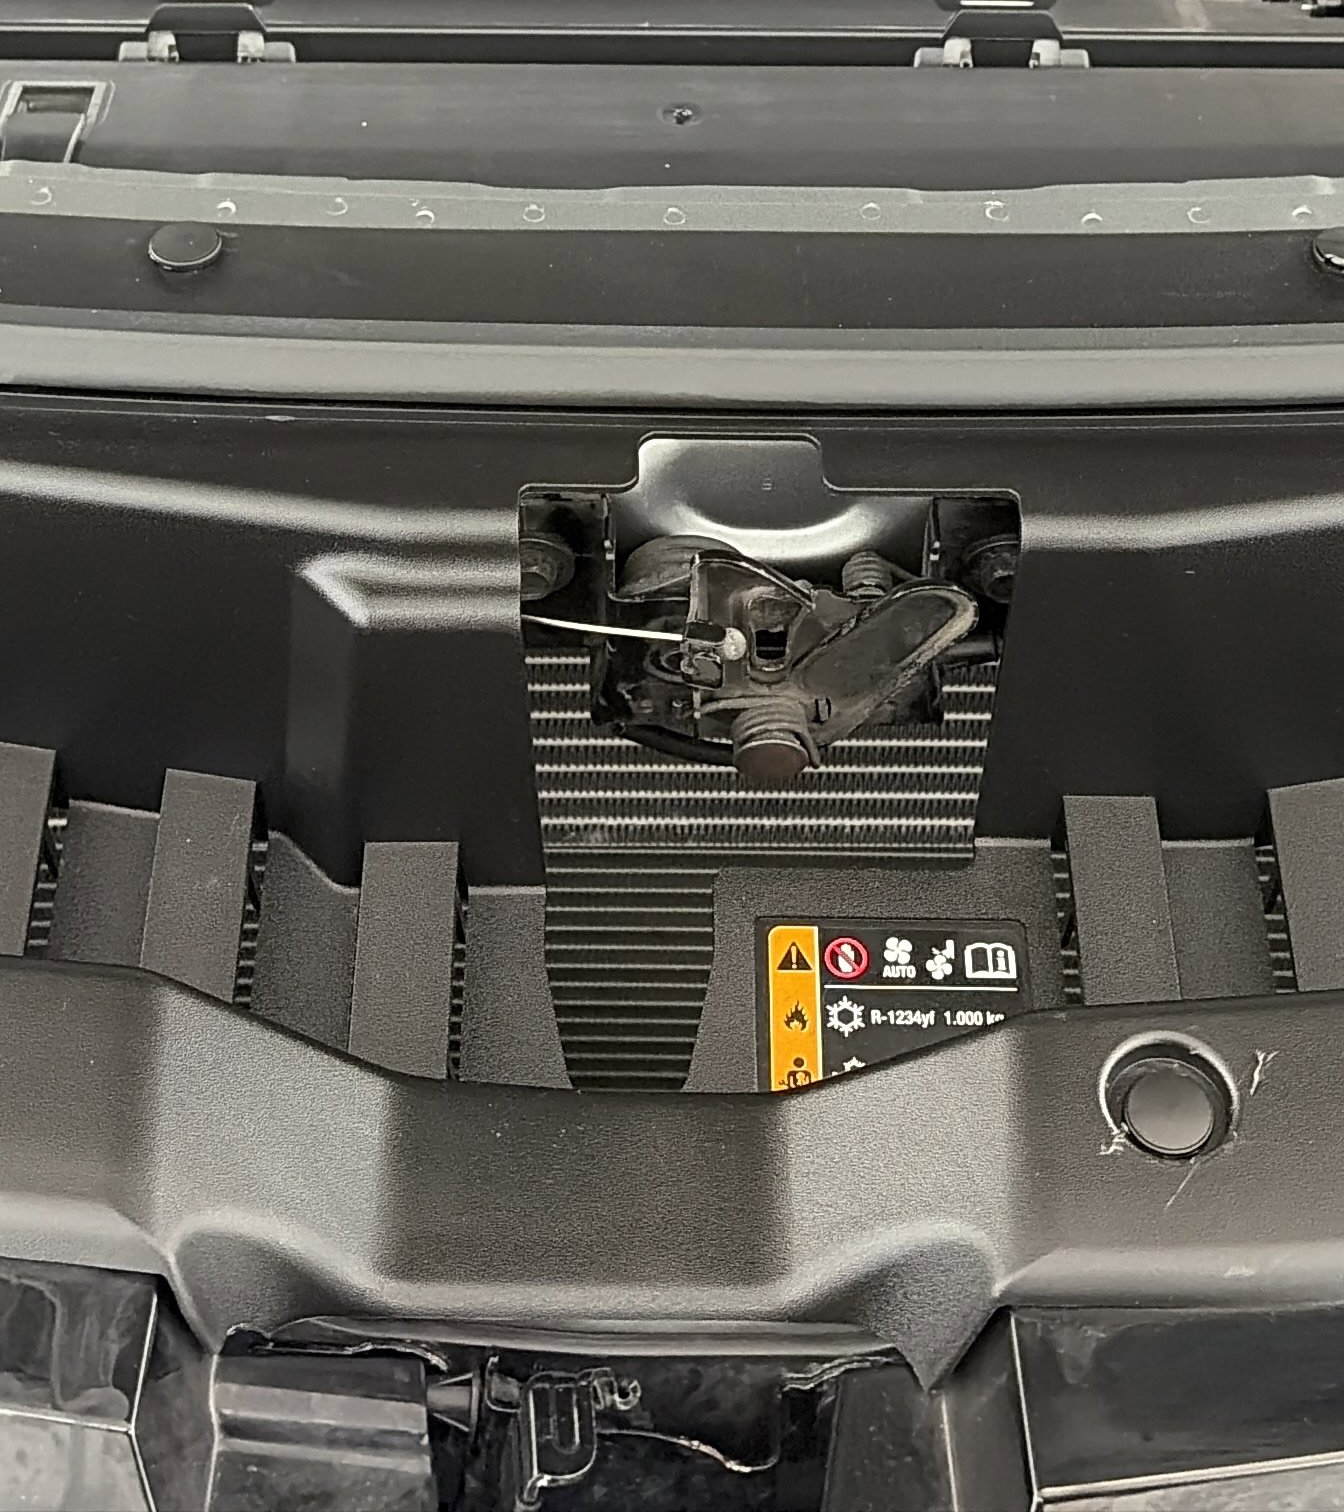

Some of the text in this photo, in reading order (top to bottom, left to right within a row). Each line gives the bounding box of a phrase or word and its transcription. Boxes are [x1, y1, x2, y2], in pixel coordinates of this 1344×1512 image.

[882, 965, 917, 978] AUTO
[870, 1009, 936, 1028] R-1234yf
[943, 1010, 984, 1026] 1.000
